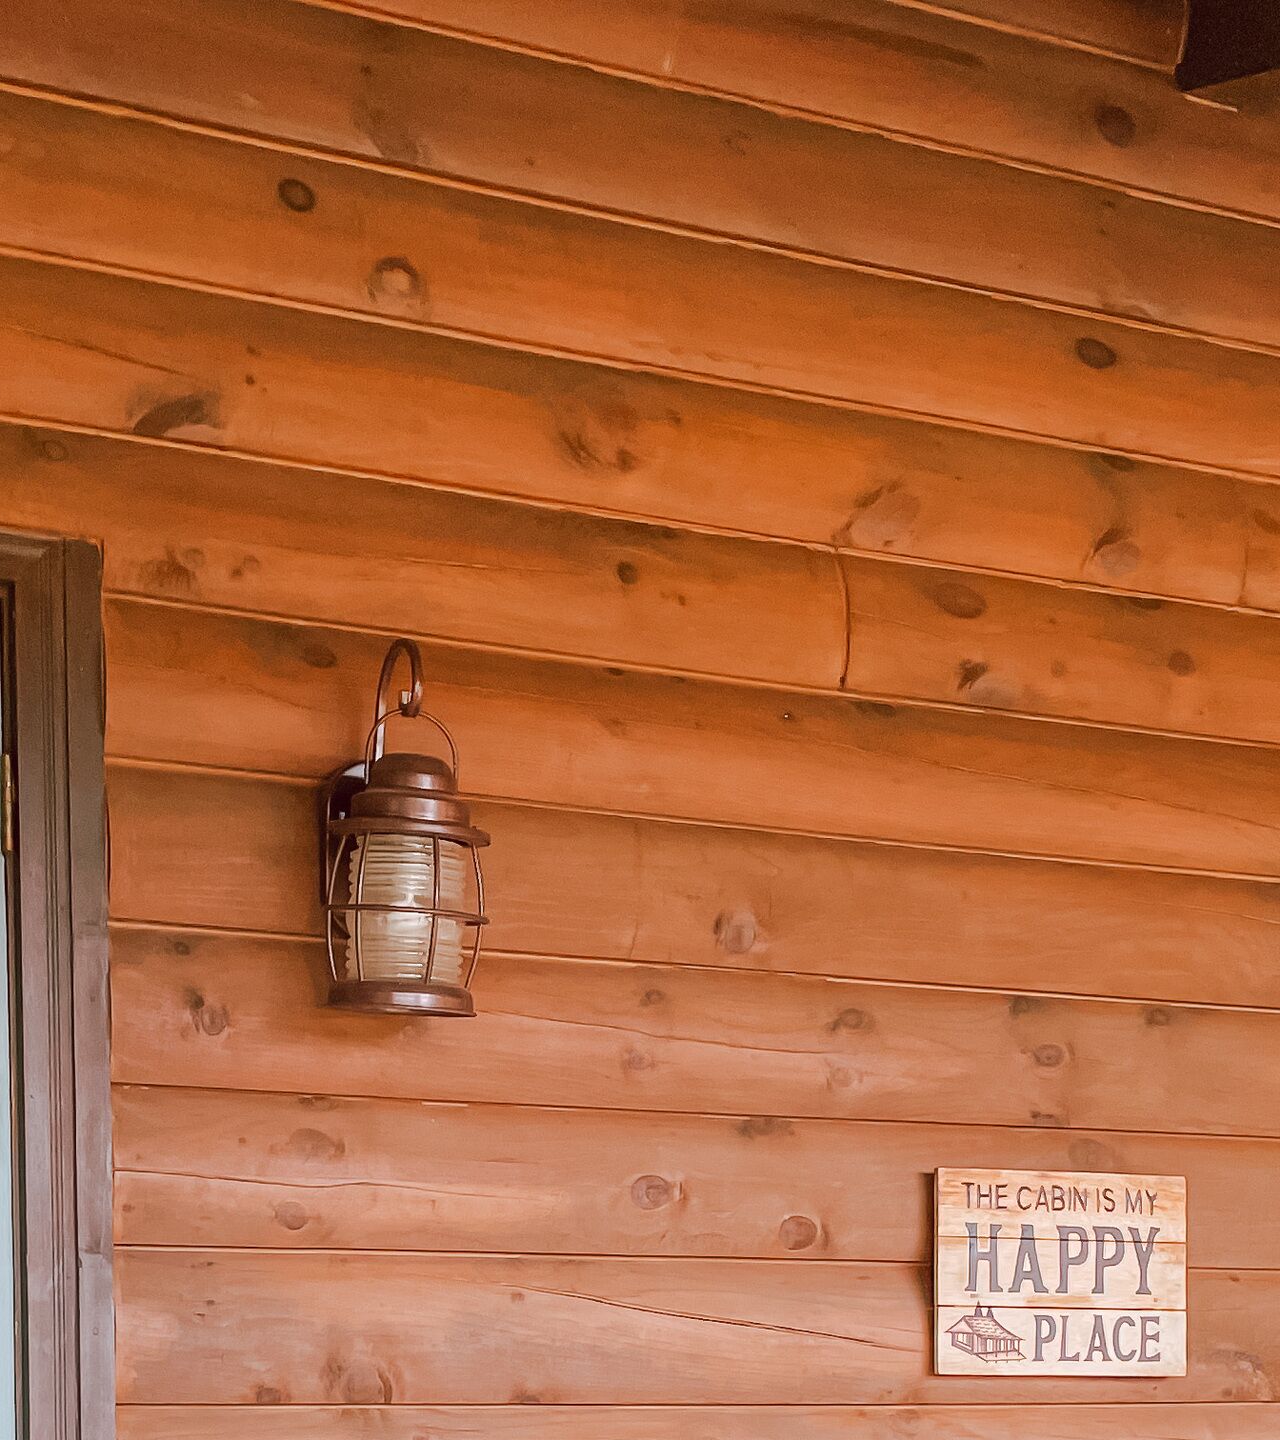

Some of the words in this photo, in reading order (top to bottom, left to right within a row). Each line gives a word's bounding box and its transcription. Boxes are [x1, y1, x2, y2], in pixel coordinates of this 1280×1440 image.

[961, 1182, 1009, 1210] THE
[1016, 1184, 1088, 1213] CABIN
[1096, 1187, 1116, 1213] IS
[1125, 1187, 1158, 1216] MY
[964, 1222, 1161, 1295] HAPPY
[1032, 1314, 1161, 1362] PLACE
